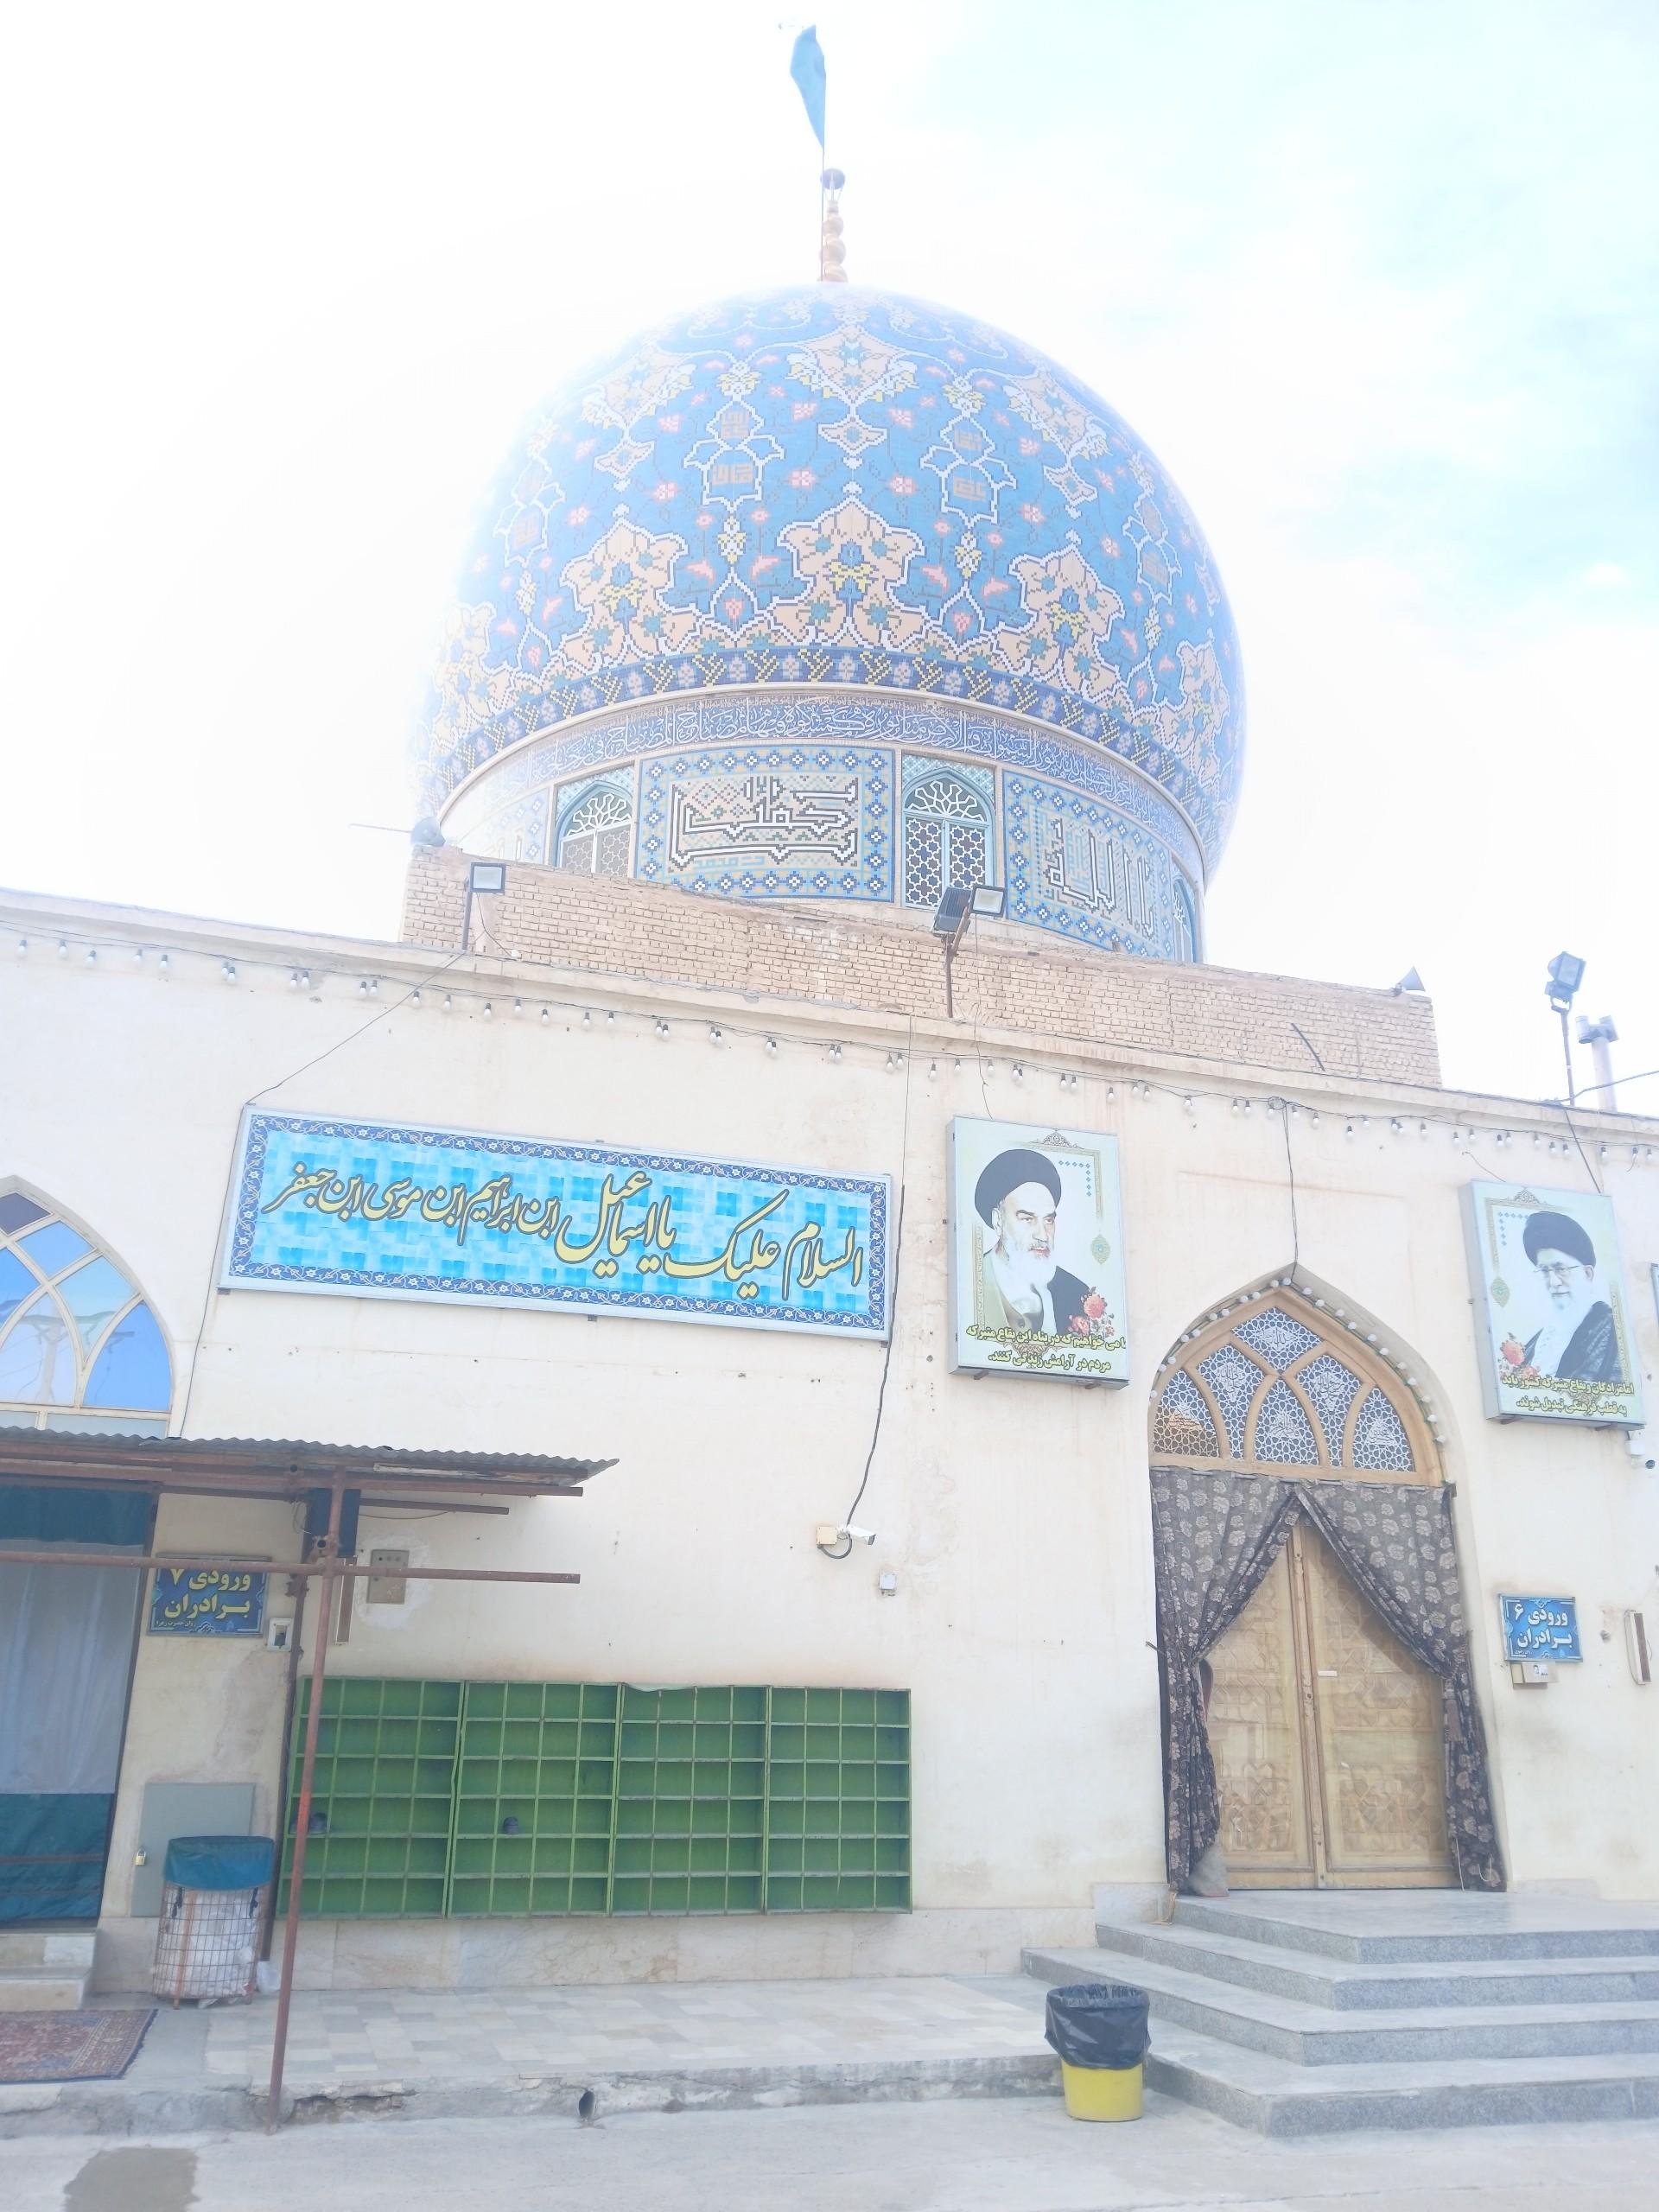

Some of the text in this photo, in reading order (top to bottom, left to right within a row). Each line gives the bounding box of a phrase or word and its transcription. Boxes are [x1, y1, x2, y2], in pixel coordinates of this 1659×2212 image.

[261, 1161, 337, 1213] جعفر
[317, 1174, 364, 1222] ابن
[360, 1178, 423, 1220] موسی
[421, 1185, 467, 1228] ابن
[457, 1174, 524, 1246] ابراهیم
[516, 1196, 560, 1240] ابن
[554, 1170, 658, 1279] اسماعیل
[663, 1189, 790, 1300] علیک
[782, 1221, 863, 1300] السلام
[1050, 1333, 1060, 1346] در
[1061, 1332, 1072, 1344] که
[1044, 1353, 1076, 1370] آرامش
[1076, 1358, 1087, 1371] در
[1088, 1359, 1111, 1373] مردم
[188, 1570, 251, 1592] ورودی
[164, 1593, 251, 1619] برادران
[1514, 1603, 1568, 1626] ورودی ۶
[1517, 1628, 1573, 1649] برادران
